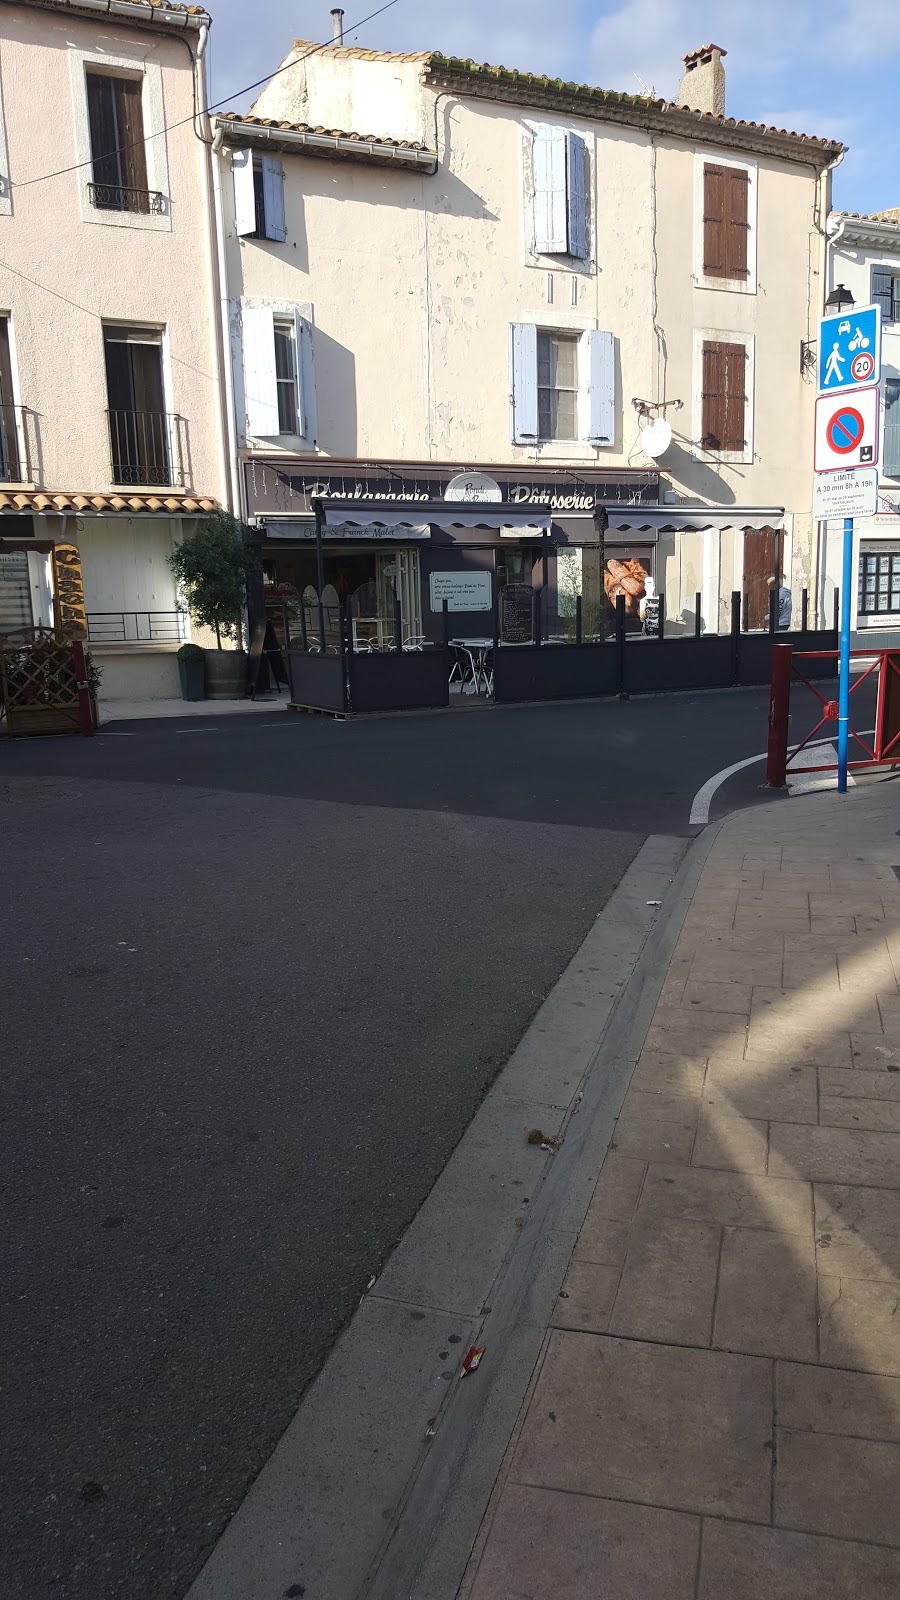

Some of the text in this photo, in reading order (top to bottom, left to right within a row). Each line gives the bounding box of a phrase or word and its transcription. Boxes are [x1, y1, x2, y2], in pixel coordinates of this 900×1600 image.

[856, 361, 870, 373] 20
[823, 485, 831, 493] 30
[832, 483, 844, 492] min
[854, 481, 860, 489] A
[861, 480, 873, 488] 19h
